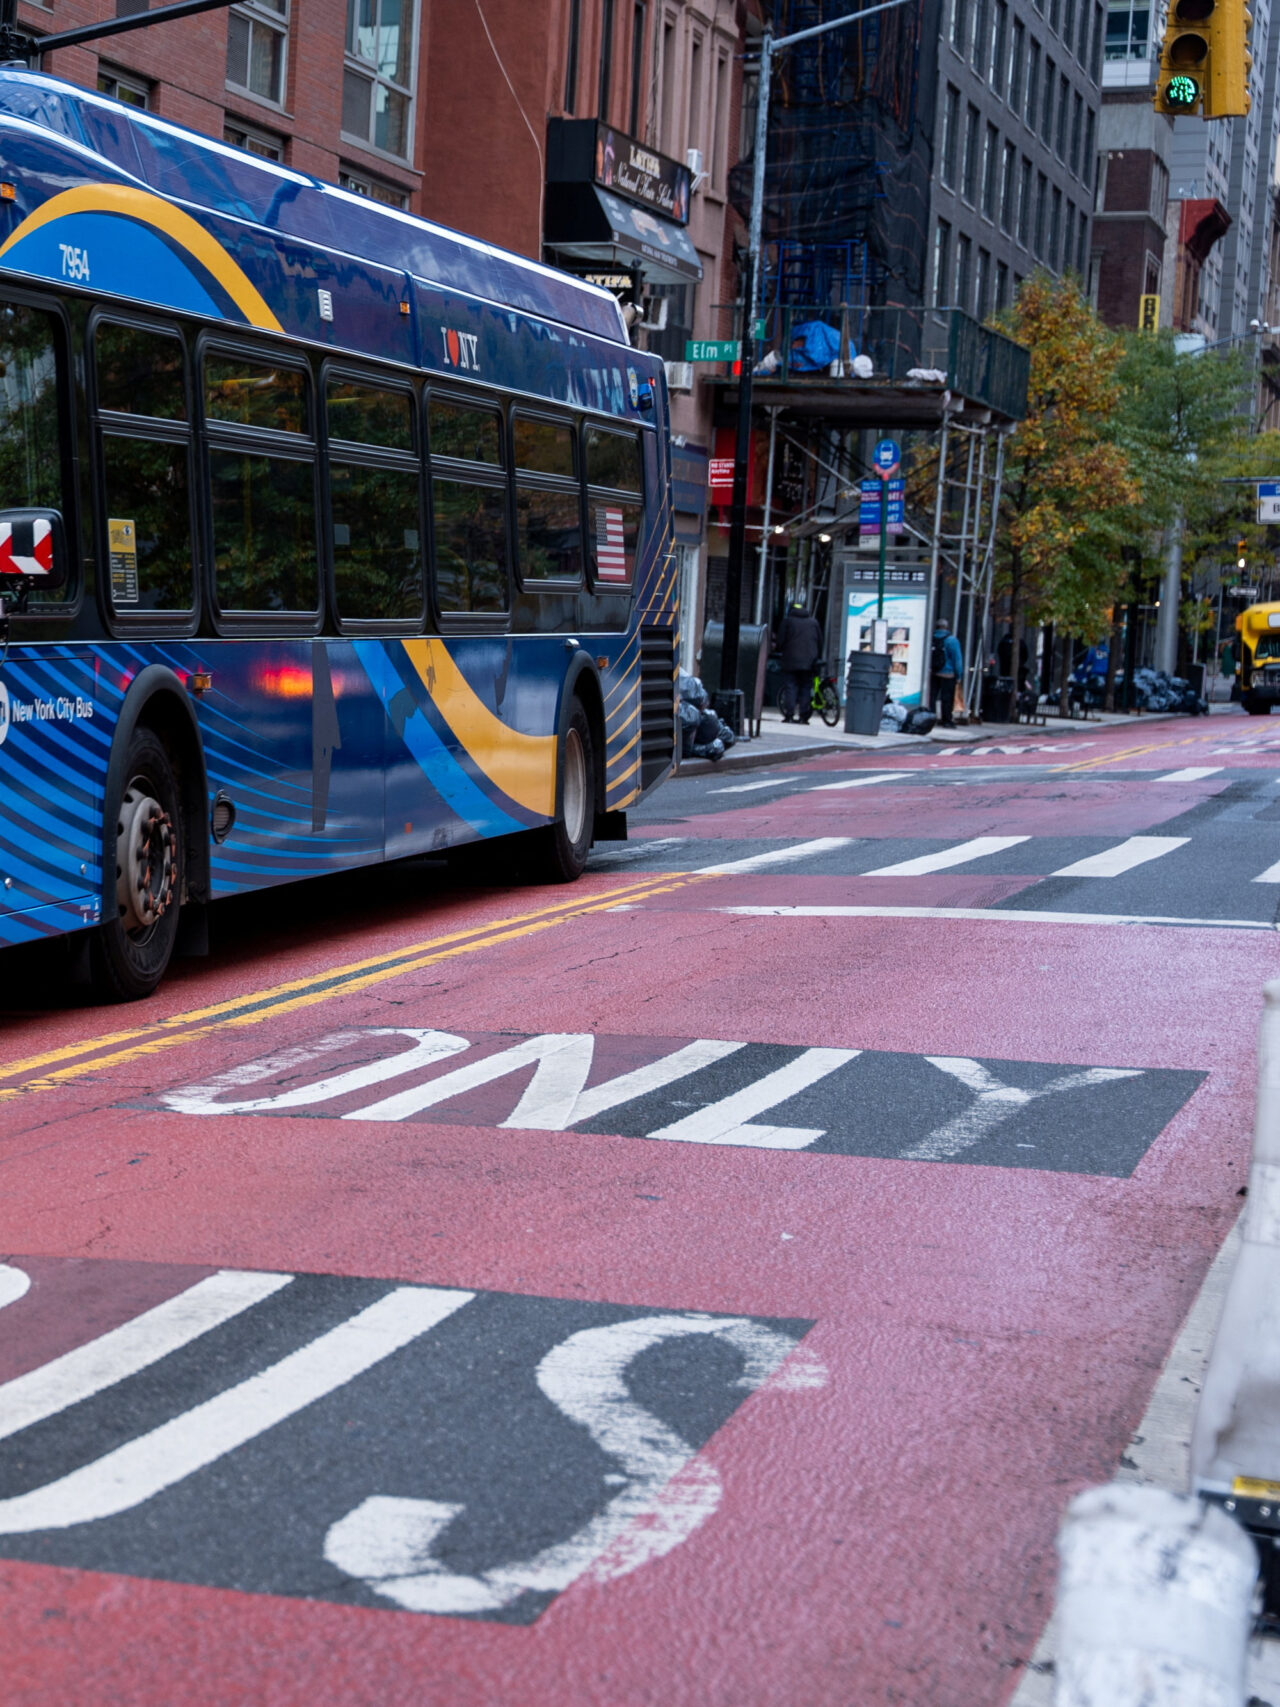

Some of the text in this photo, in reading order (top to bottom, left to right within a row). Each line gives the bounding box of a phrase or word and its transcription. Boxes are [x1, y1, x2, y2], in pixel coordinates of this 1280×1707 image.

[58, 243, 90, 281] 7954
[575, 273, 633, 288] ATIFA
[692, 343, 718, 359] Elm
[12, 697, 93, 723] New York City Bus
[156, 1027, 1146, 1161] ONLY
